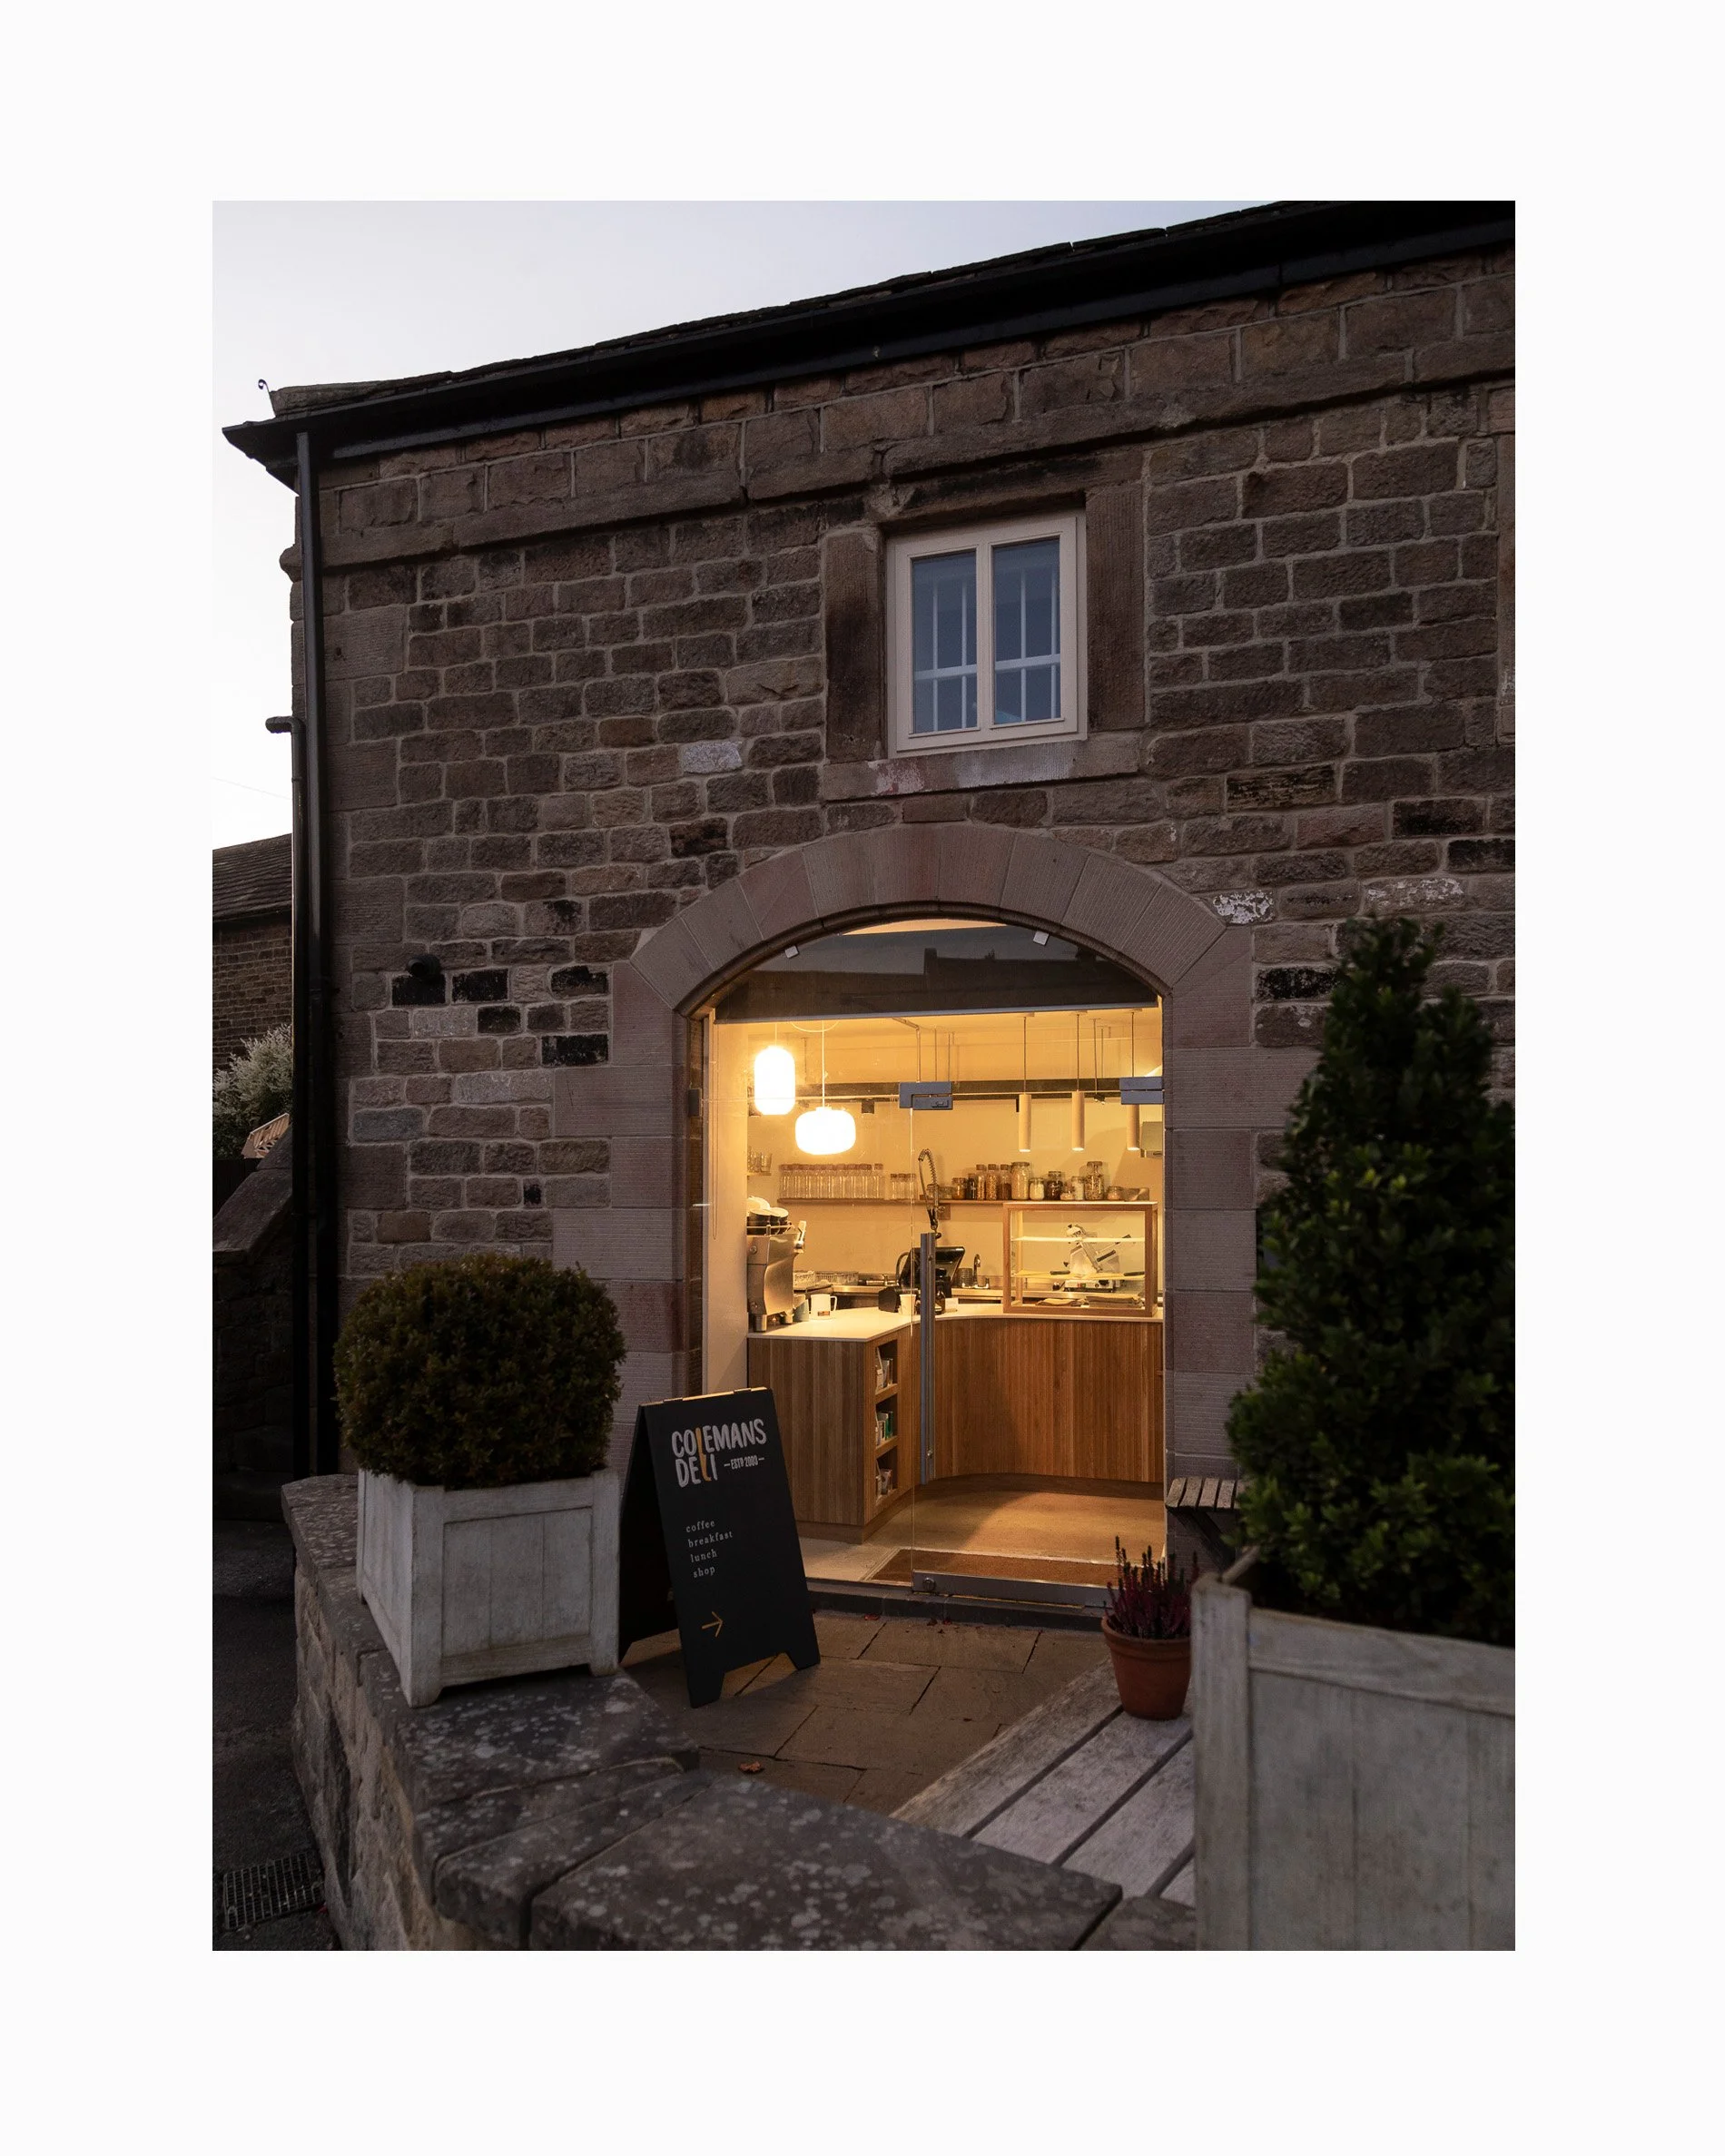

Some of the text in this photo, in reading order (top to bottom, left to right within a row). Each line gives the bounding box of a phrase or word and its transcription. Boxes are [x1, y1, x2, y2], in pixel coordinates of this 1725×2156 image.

[672, 1418, 767, 1458] COLEMANS
[675, 1453, 717, 1488] DELI
[685, 1520, 715, 1533] coffee
[687, 1531, 734, 1548] breakfast
[690, 1548, 717, 1563] lunch
[693, 1566, 715, 1579] shop
